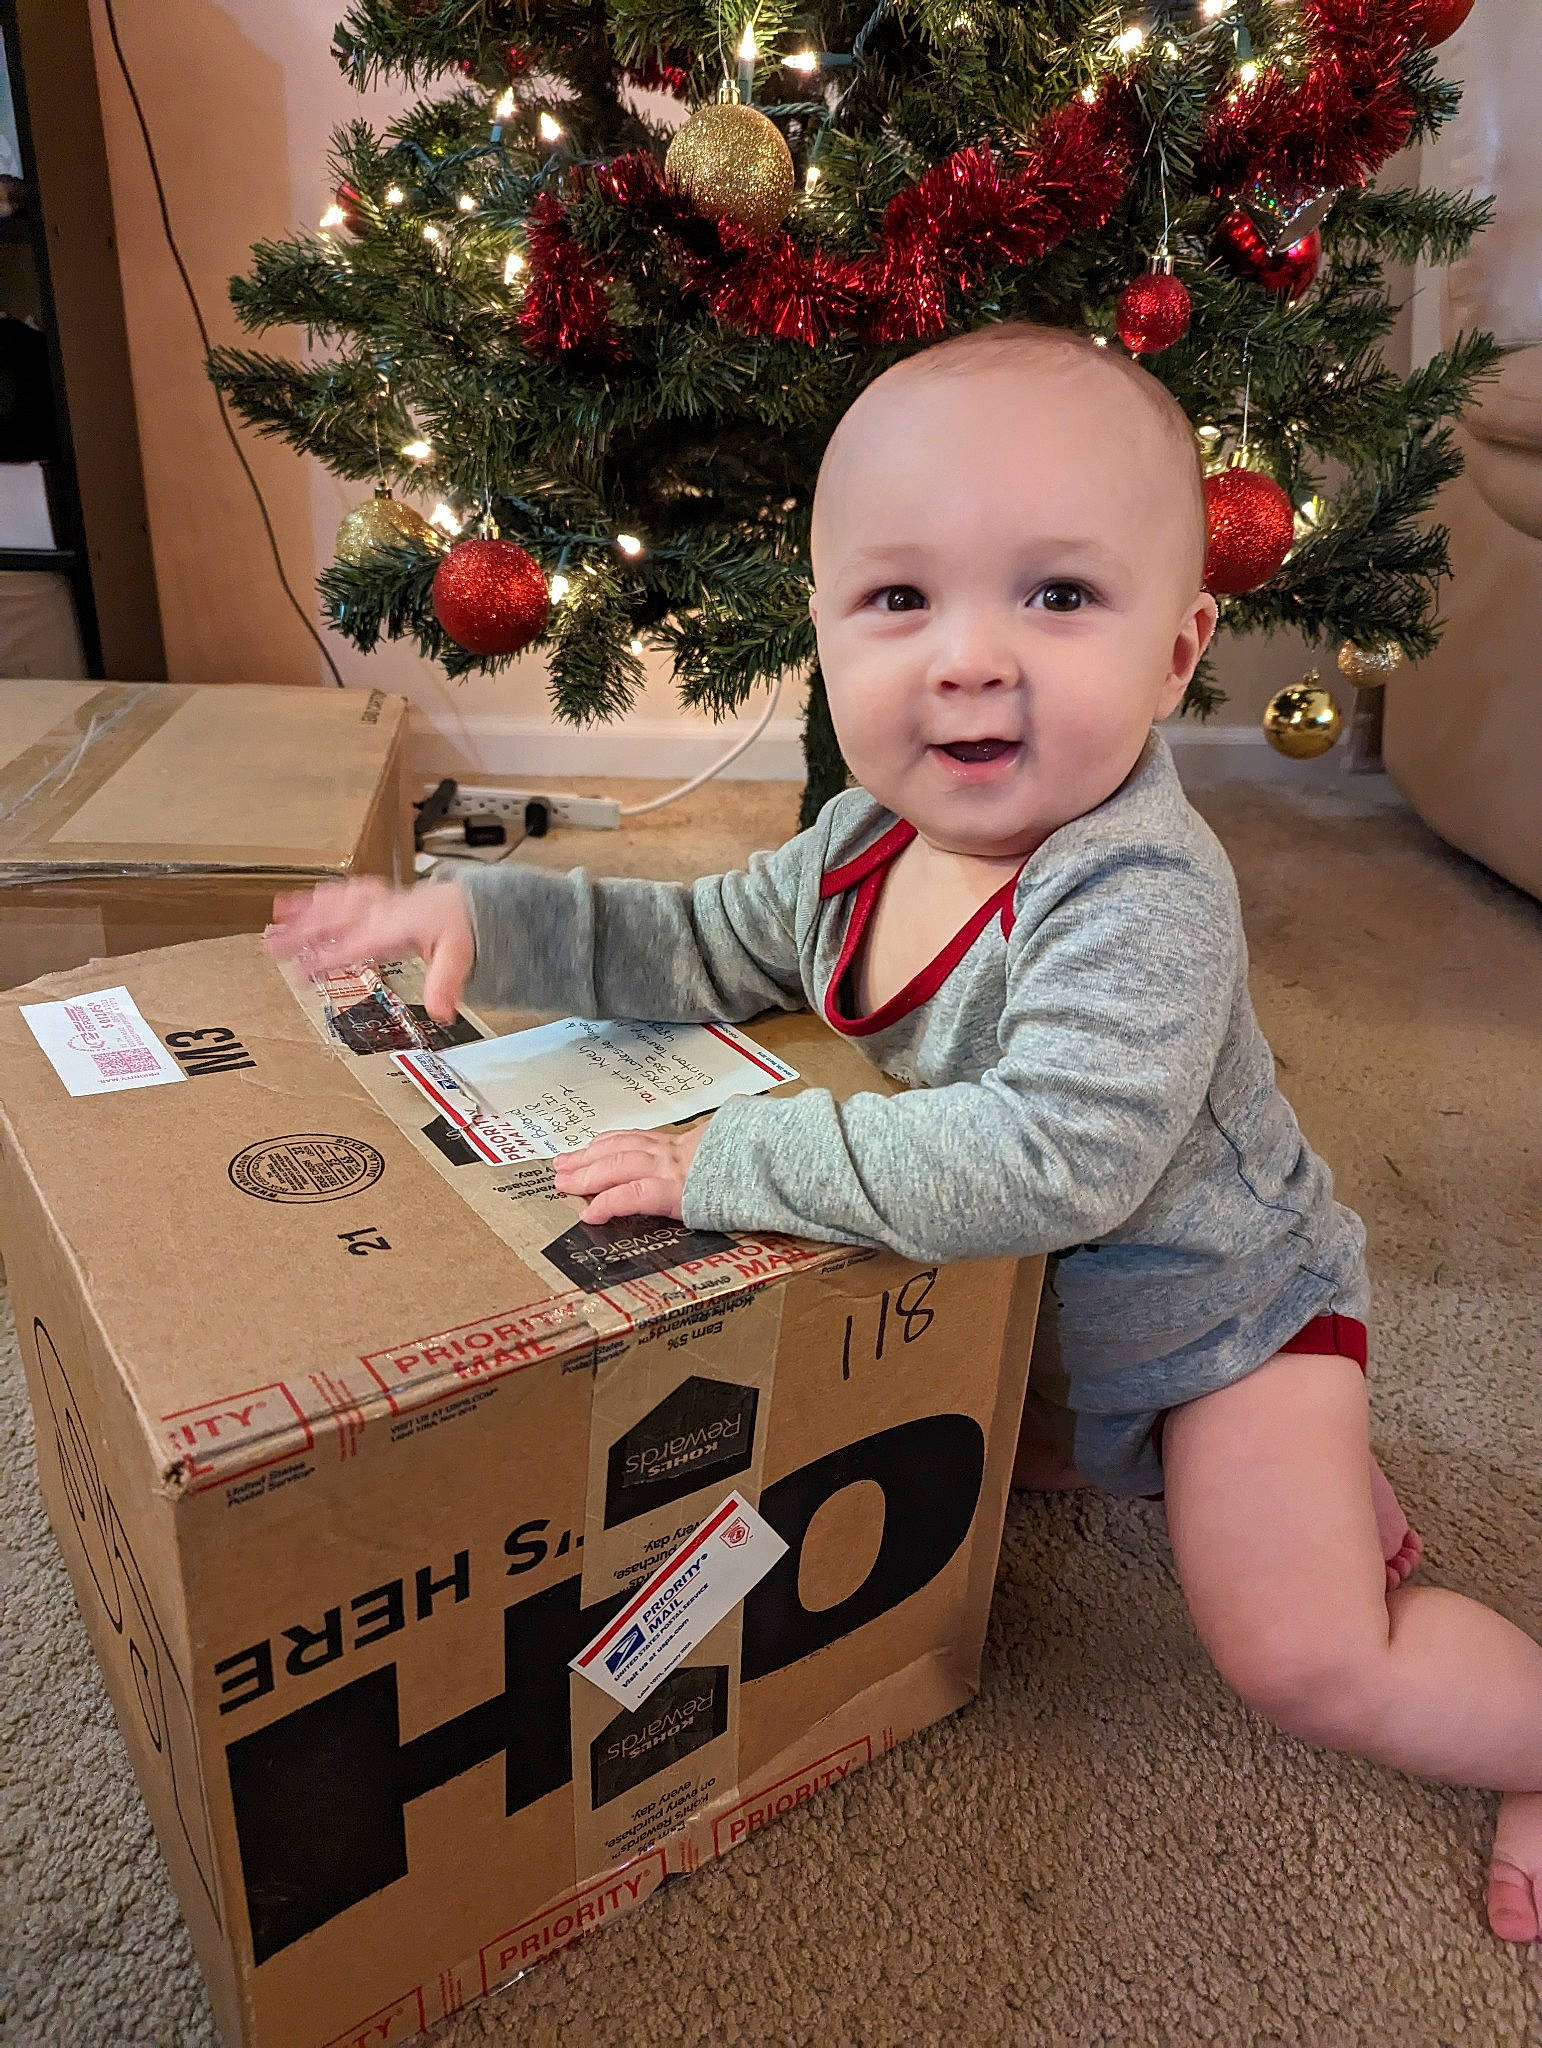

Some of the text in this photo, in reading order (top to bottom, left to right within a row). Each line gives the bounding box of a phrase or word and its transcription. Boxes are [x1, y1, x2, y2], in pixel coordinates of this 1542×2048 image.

[165, 1027, 258, 1077] M3
[498, 1122, 532, 1147] MAIL
[337, 1227, 392, 1256] 21
[570, 1228, 695, 1264] Rewards
[667, 1321, 723, 1351] Earn 5%
[843, 1266, 938, 1380] 118
[453, 1337, 556, 1380] MAIL
[626, 1413, 742, 1473] Rewards
[647, 1441, 719, 1477] KOHL'S
[643, 1534, 671, 1553] day.
[214, 1549, 471, 1716] HERE
[614, 1582, 710, 1682] UNITED STATES POSTAL SERVICE
[648, 1597, 685, 1634] MAIL
[621, 1671, 640, 1689] Visit
[608, 1688, 714, 1760] Rewards
[604, 1777, 717, 1848] on every purchase,
[630, 1780, 692, 1821] every day.
